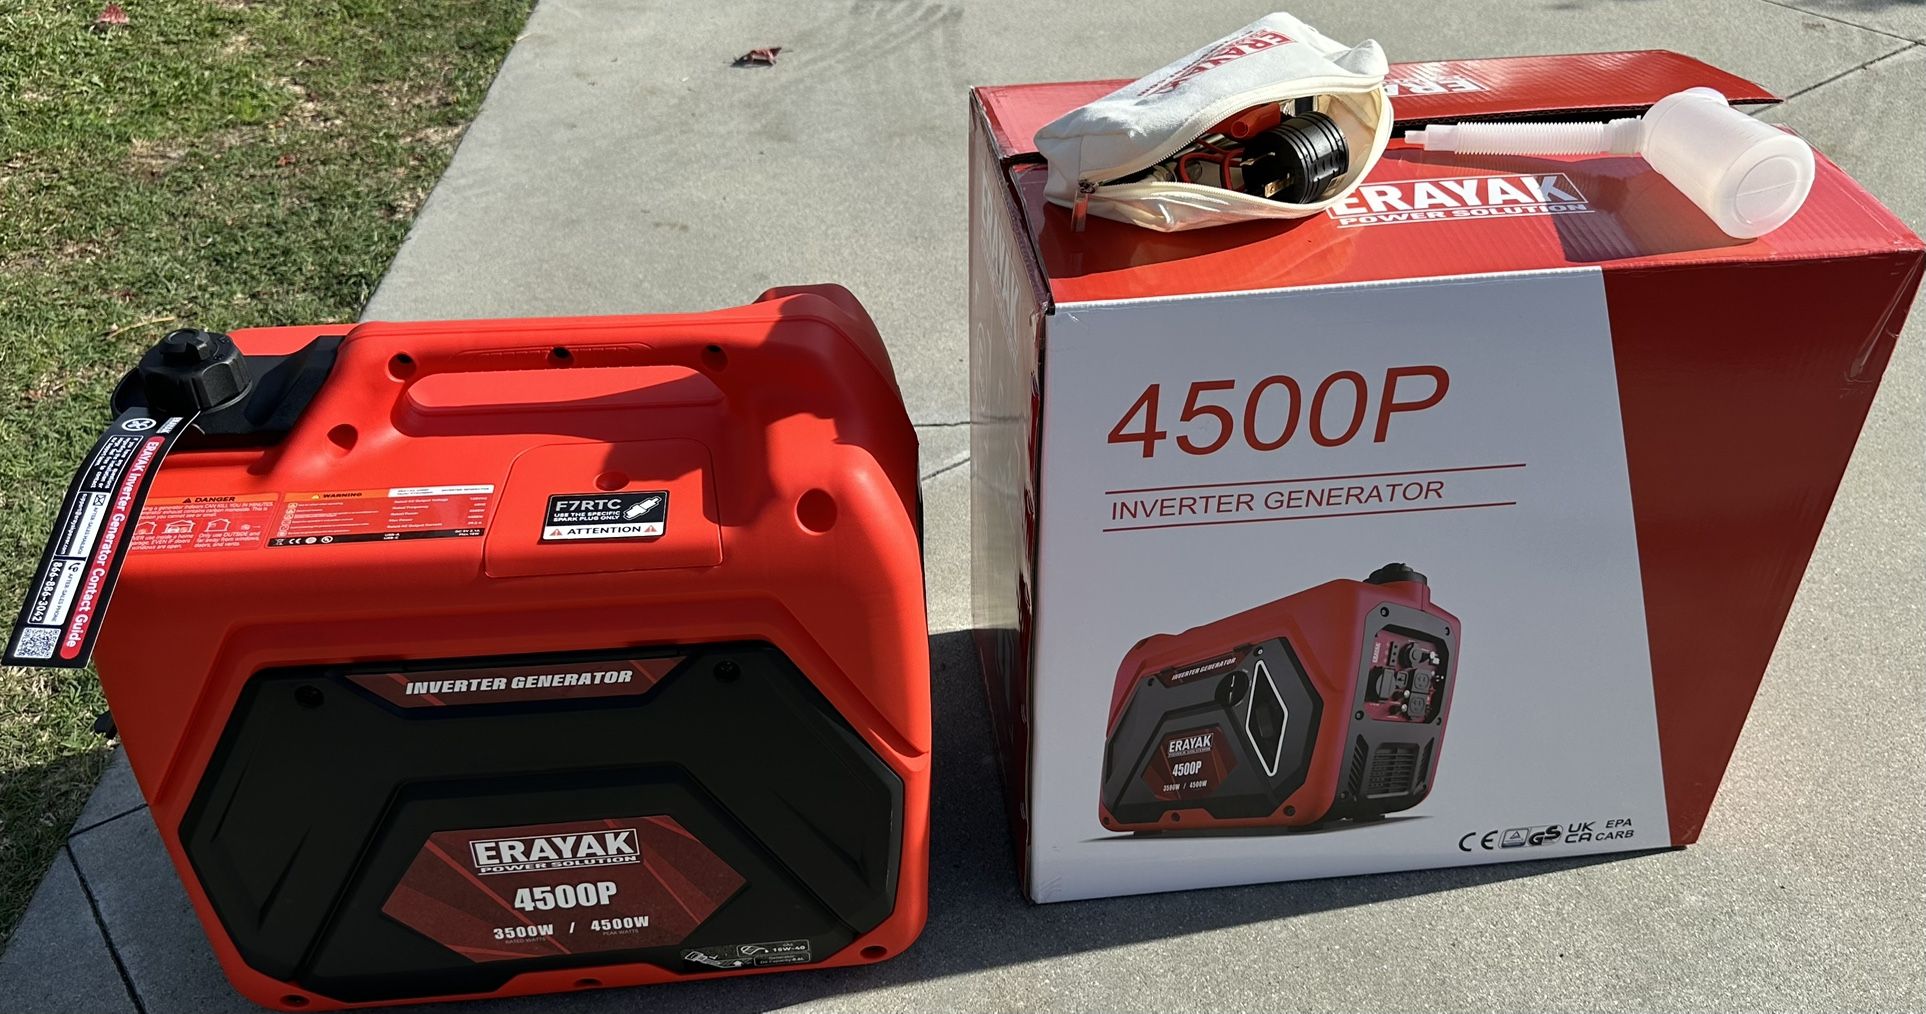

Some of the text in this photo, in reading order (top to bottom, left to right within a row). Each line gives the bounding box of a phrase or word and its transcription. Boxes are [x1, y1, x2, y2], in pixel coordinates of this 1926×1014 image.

[1333, 176, 1578, 216] ERAYAK
[1340, 203, 1587, 226] POWER SOLUTION
[1107, 365, 1450, 459] 4500P
[131, 441, 160, 472] ERAYAK
[116, 473, 142, 512] Inverter
[555, 499, 622, 512] F7RTC
[1111, 480, 1445, 520] INVERTER GENERATOR
[96, 513, 125, 566] Generator
[567, 526, 641, 535] ATTENTION
[31, 562, 63, 622] 866-886-3042
[79, 568, 105, 612] Contact
[66, 614, 88, 647] Guide
[405, 670, 633, 695] INVERTER GENERATOR
[1168, 734, 1212, 753] ERAYAK
[1172, 761, 1202, 777] 4500P
[1528, 825, 1561, 846] GS
[1568, 821, 1596, 833] UK
[1605, 818, 1632, 829] EPA
[1595, 829, 1634, 842] CARB
[474, 831, 635, 865] ERAYAK
[480, 855, 637, 874] POWER SOLUTION
[514, 881, 617, 912] 4500P
[493, 924, 554, 940] 3500W
[590, 915, 649, 931] 4500W
